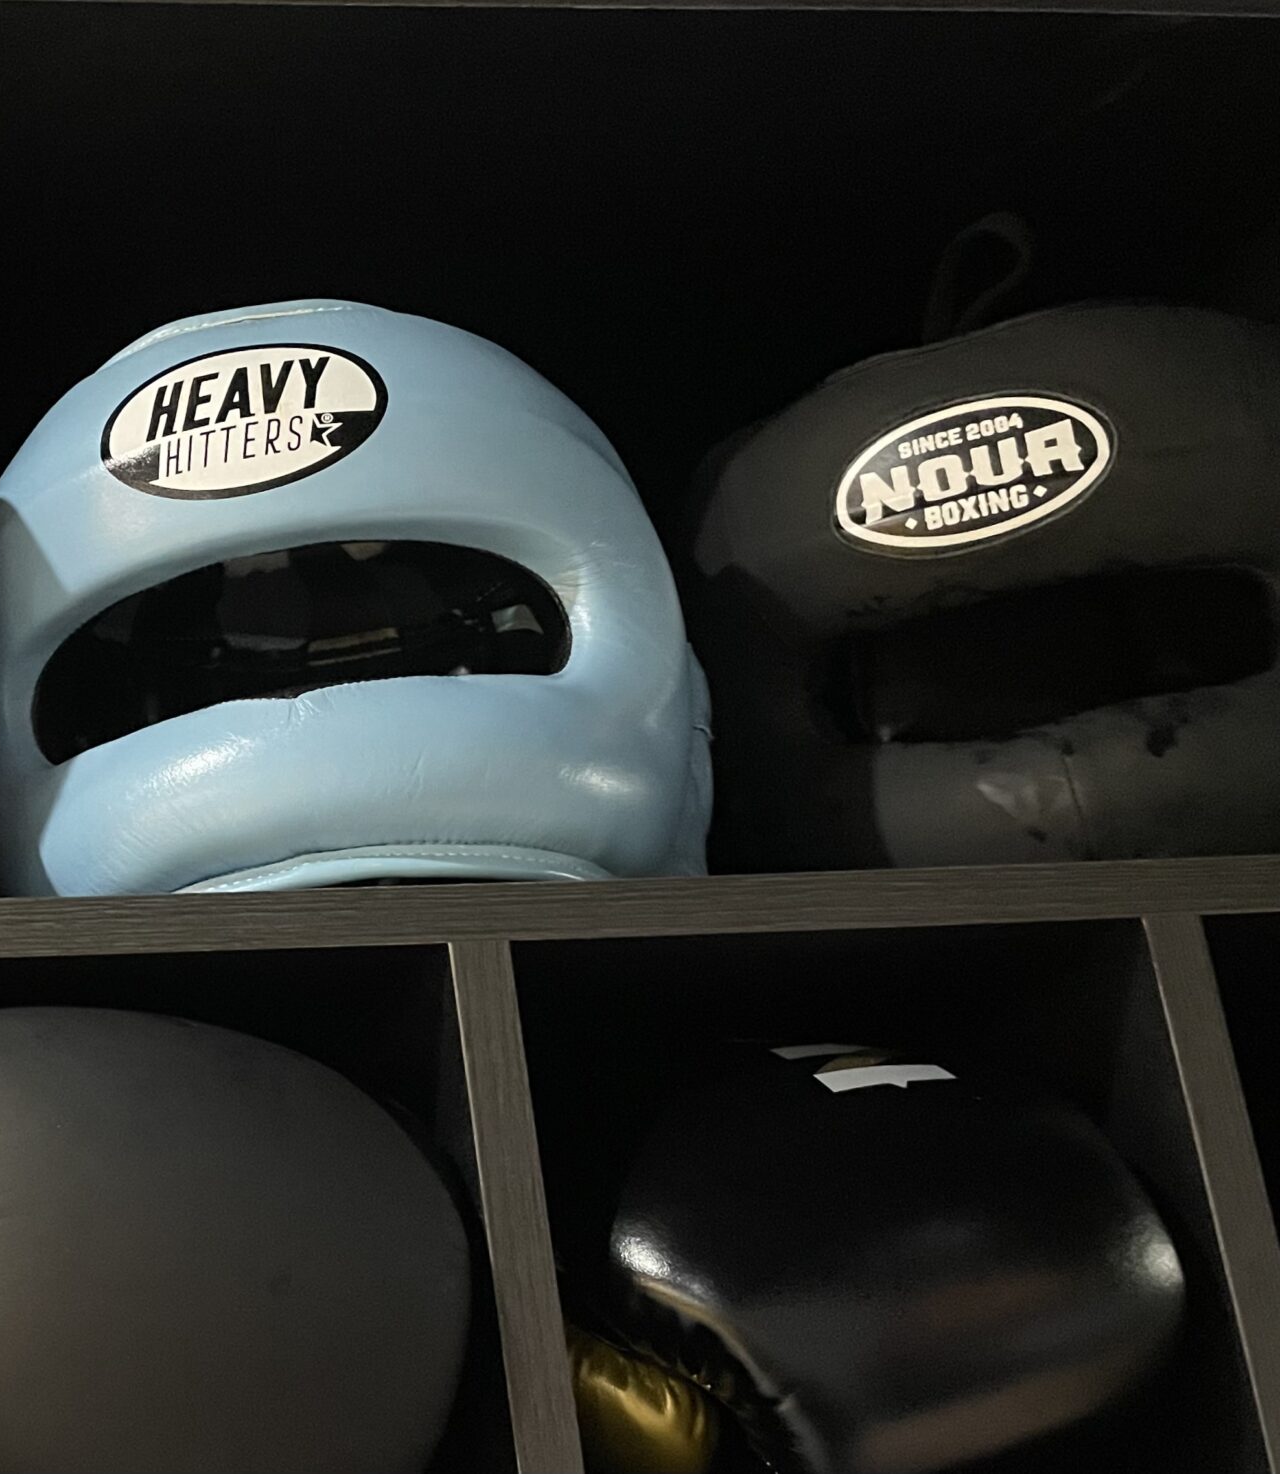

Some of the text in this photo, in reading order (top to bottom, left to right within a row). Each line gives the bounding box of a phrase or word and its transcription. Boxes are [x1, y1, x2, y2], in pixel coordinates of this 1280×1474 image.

[145, 356, 331, 443] HEAVY
[166, 415, 303, 477] HITTERS
[897, 413, 1024, 460] SINCE 2004
[923, 485, 1030, 531] BOXING
